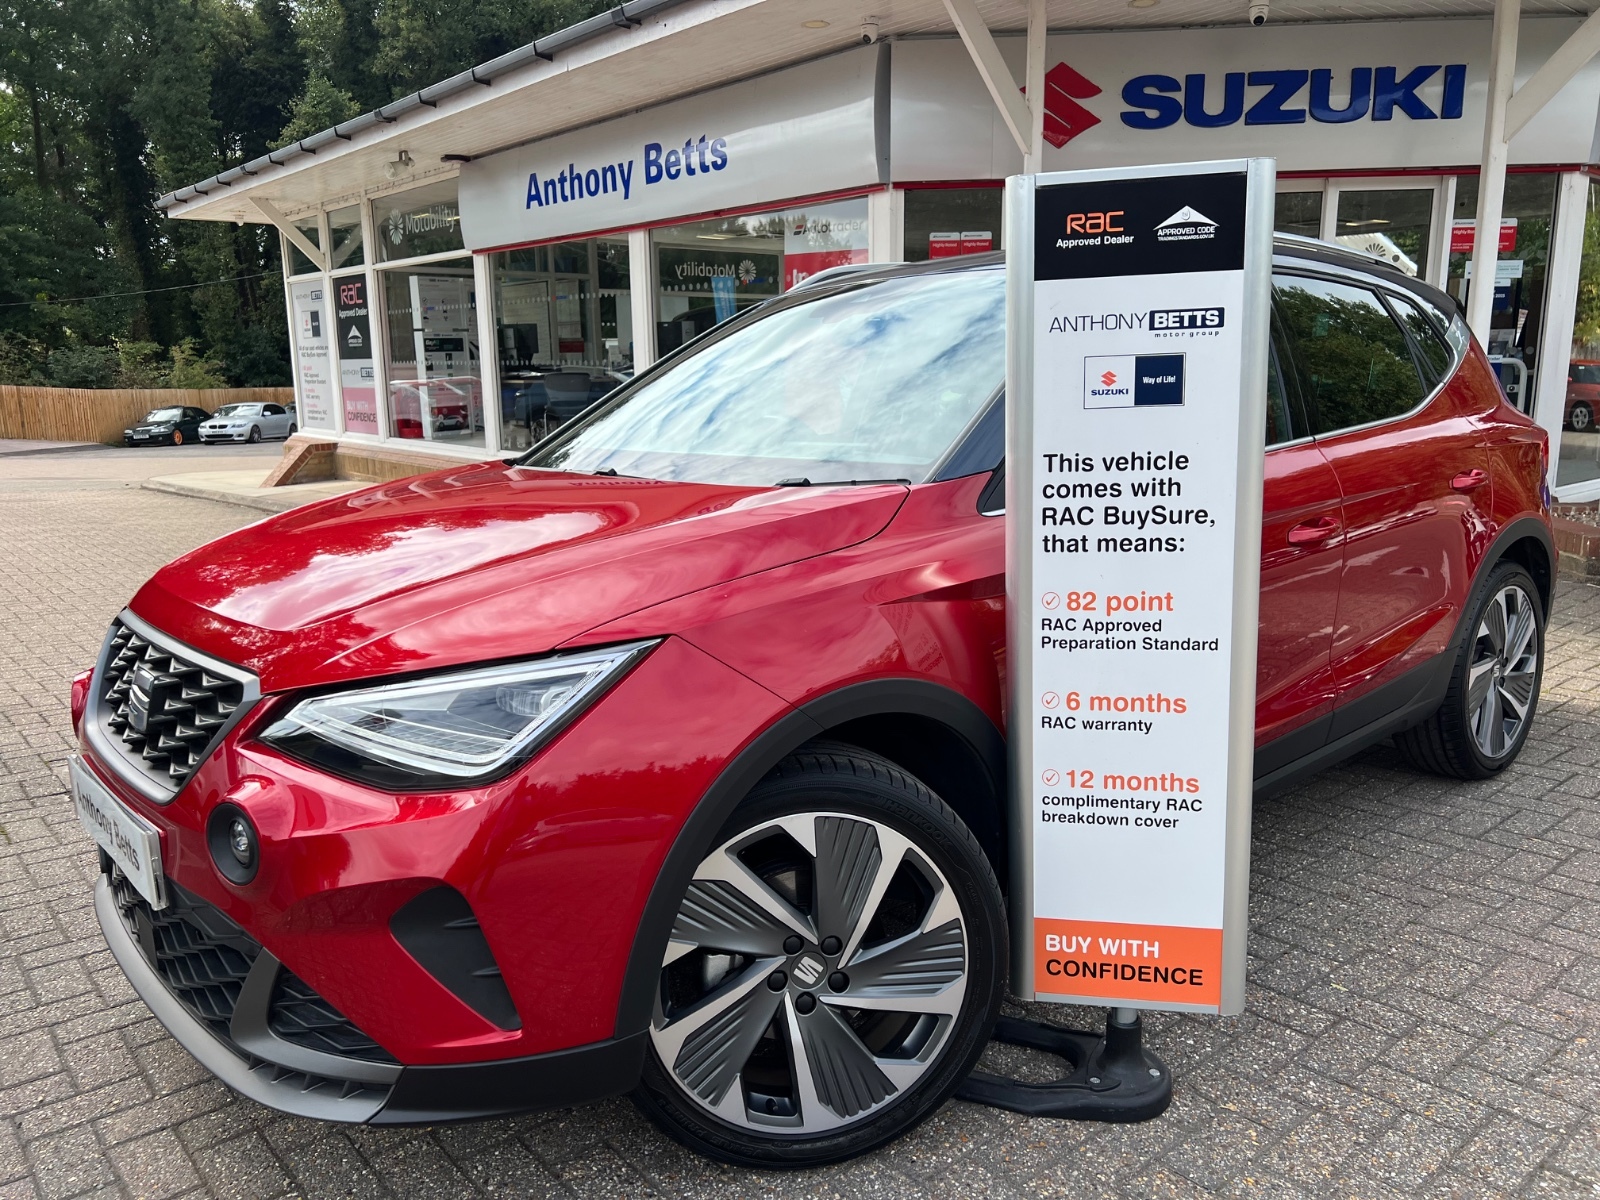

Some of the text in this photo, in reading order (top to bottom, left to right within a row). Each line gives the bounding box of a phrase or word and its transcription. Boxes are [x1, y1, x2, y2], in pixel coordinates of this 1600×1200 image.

[1120, 64, 1467, 130] SUZUKI
[526, 134, 728, 209] Anthony Betts
[405, 205, 455, 235] Motability
[1157, 226, 1216, 236] APPROVED CODE
[1056, 235, 1134, 249] Approved Dealer
[1049, 310, 1219, 333] ANTHONY BETTS
[1189, 330, 1220, 338] group
[1142, 376, 1155, 385] Way
[1091, 388, 1129, 396] SUZUKI
[348, 411, 377, 423] CONFIDENCE
[1042, 450, 1190, 473] This vehicle
[1042, 477, 1182, 499] comes with
[1042, 505, 1216, 530] RAC BuySure,
[1042, 534, 1185, 553] that means:
[1066, 590, 1174, 617] 82 point
[1041, 618, 1162, 635] RAC Approved
[1041, 636, 1219, 652] Preparation Standard
[1066, 691, 1187, 714] 6 months
[1041, 716, 1153, 735] RAC warranty
[1066, 769, 1200, 794] 12 months
[1042, 795, 1203, 813] complimentary RAC
[77, 782, 140, 871] Anthony Betts
[1041, 810, 1180, 829] breakdown cover
[1045, 934, 1160, 959] BUY WITH
[1046, 959, 1204, 986] CONFIDENCE
